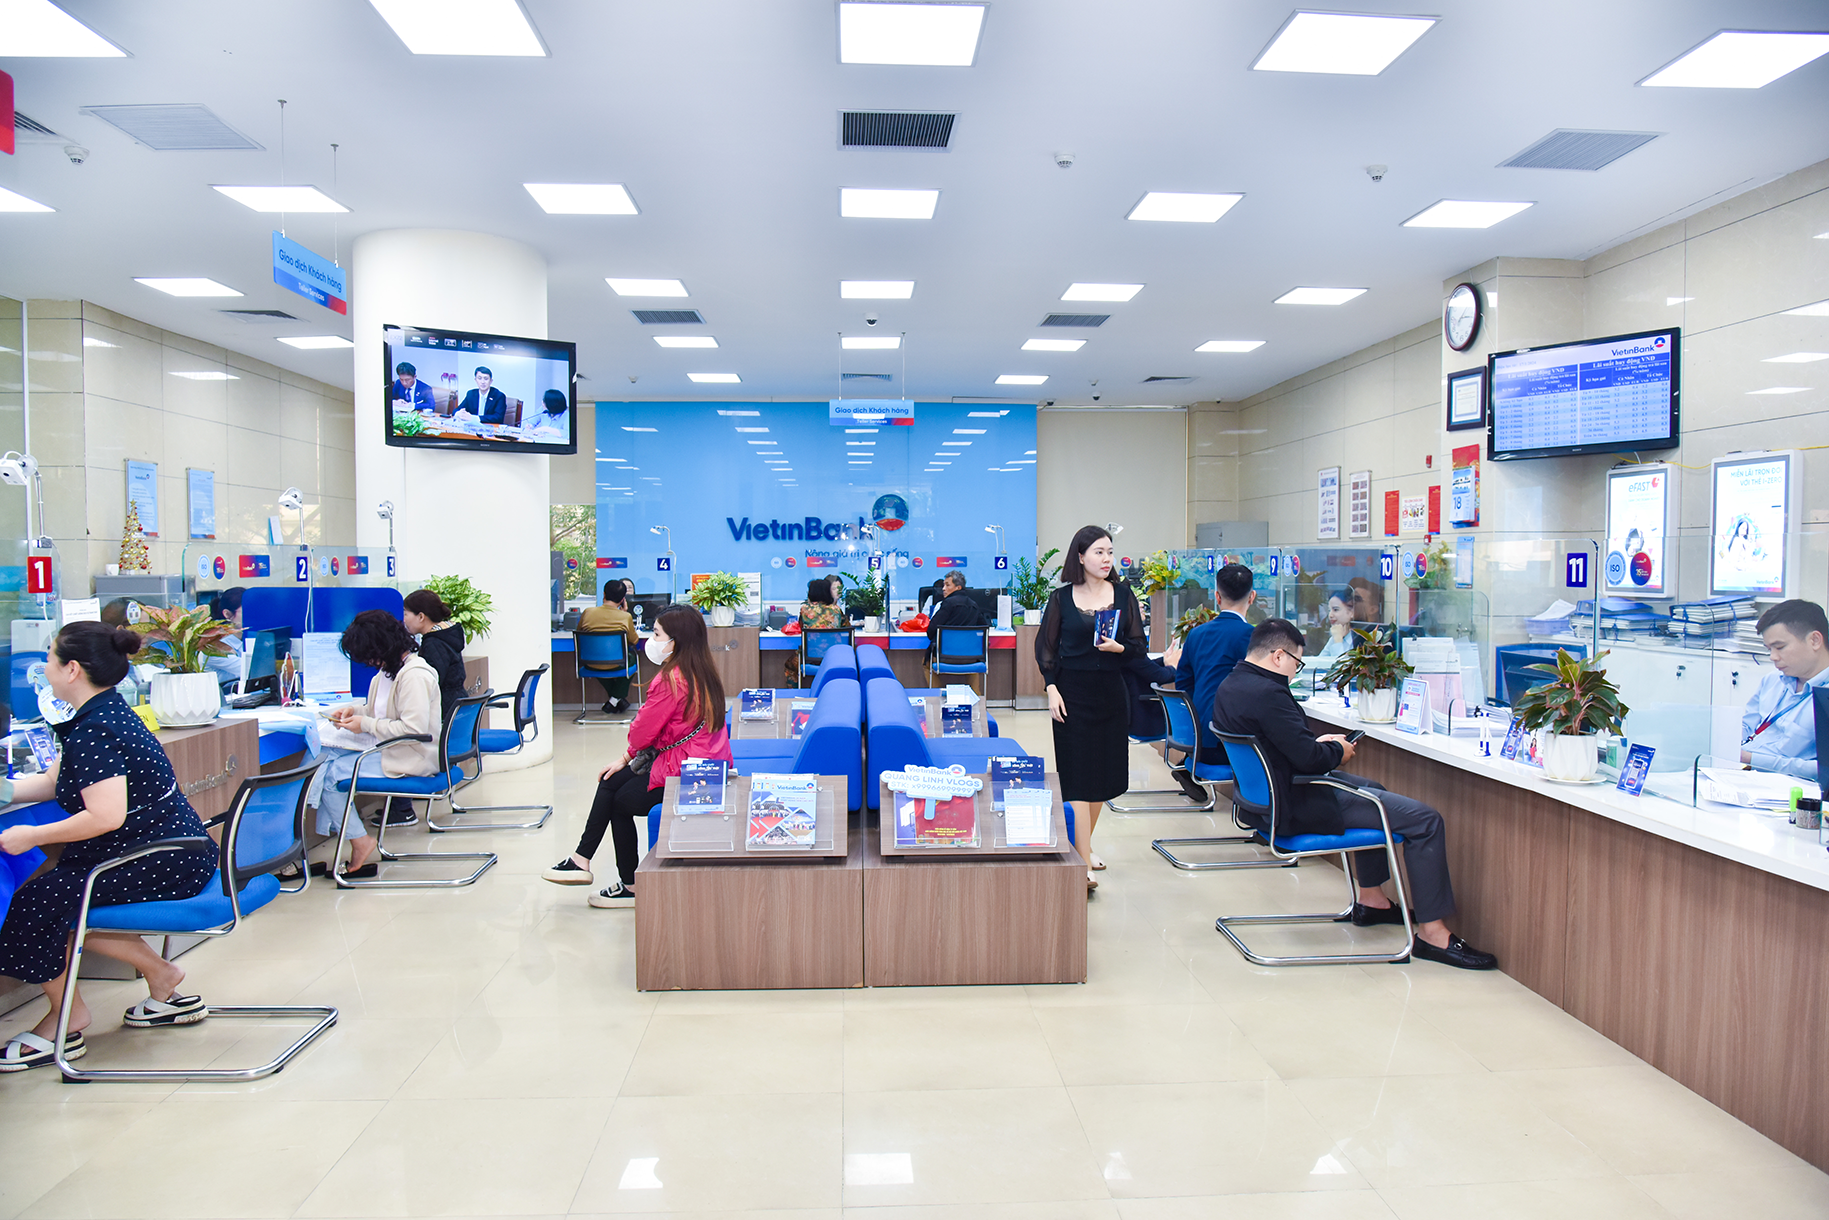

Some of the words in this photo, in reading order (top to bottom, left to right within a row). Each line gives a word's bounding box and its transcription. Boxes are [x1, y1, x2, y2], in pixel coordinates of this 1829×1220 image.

[279, 249, 294, 266] Giao
[294, 258, 308, 273] dịch
[307, 264, 327, 283] Khách
[327, 274, 342, 293] hàng
[1611, 344, 1655, 356] VietinBank
[868, 406, 890, 414] Khách
[891, 407, 909, 415] hàng
[1628, 481, 1650, 493] eFAST
[1453, 496, 1462, 510] 18
[726, 516, 875, 541] VietinBank
[298, 559, 306, 579] 2
[389, 558, 395, 576] 3
[659, 559, 669, 570] 4
[871, 558, 879, 569] 5
[997, 557, 1005, 568] 6
[1271, 557, 1276, 574] 9
[1380, 557, 1392, 577] 10
[1610, 564, 1620, 573] ISO
[34, 561, 44, 589] 1
[1568, 557, 1584, 583] 11
[908, 766, 951, 775] VietinBank
[884, 772, 920, 781] QUANG
[923, 776, 944, 784] LINH
[946, 778, 980, 787] VLOGS
[891, 780, 909, 789] STK:
